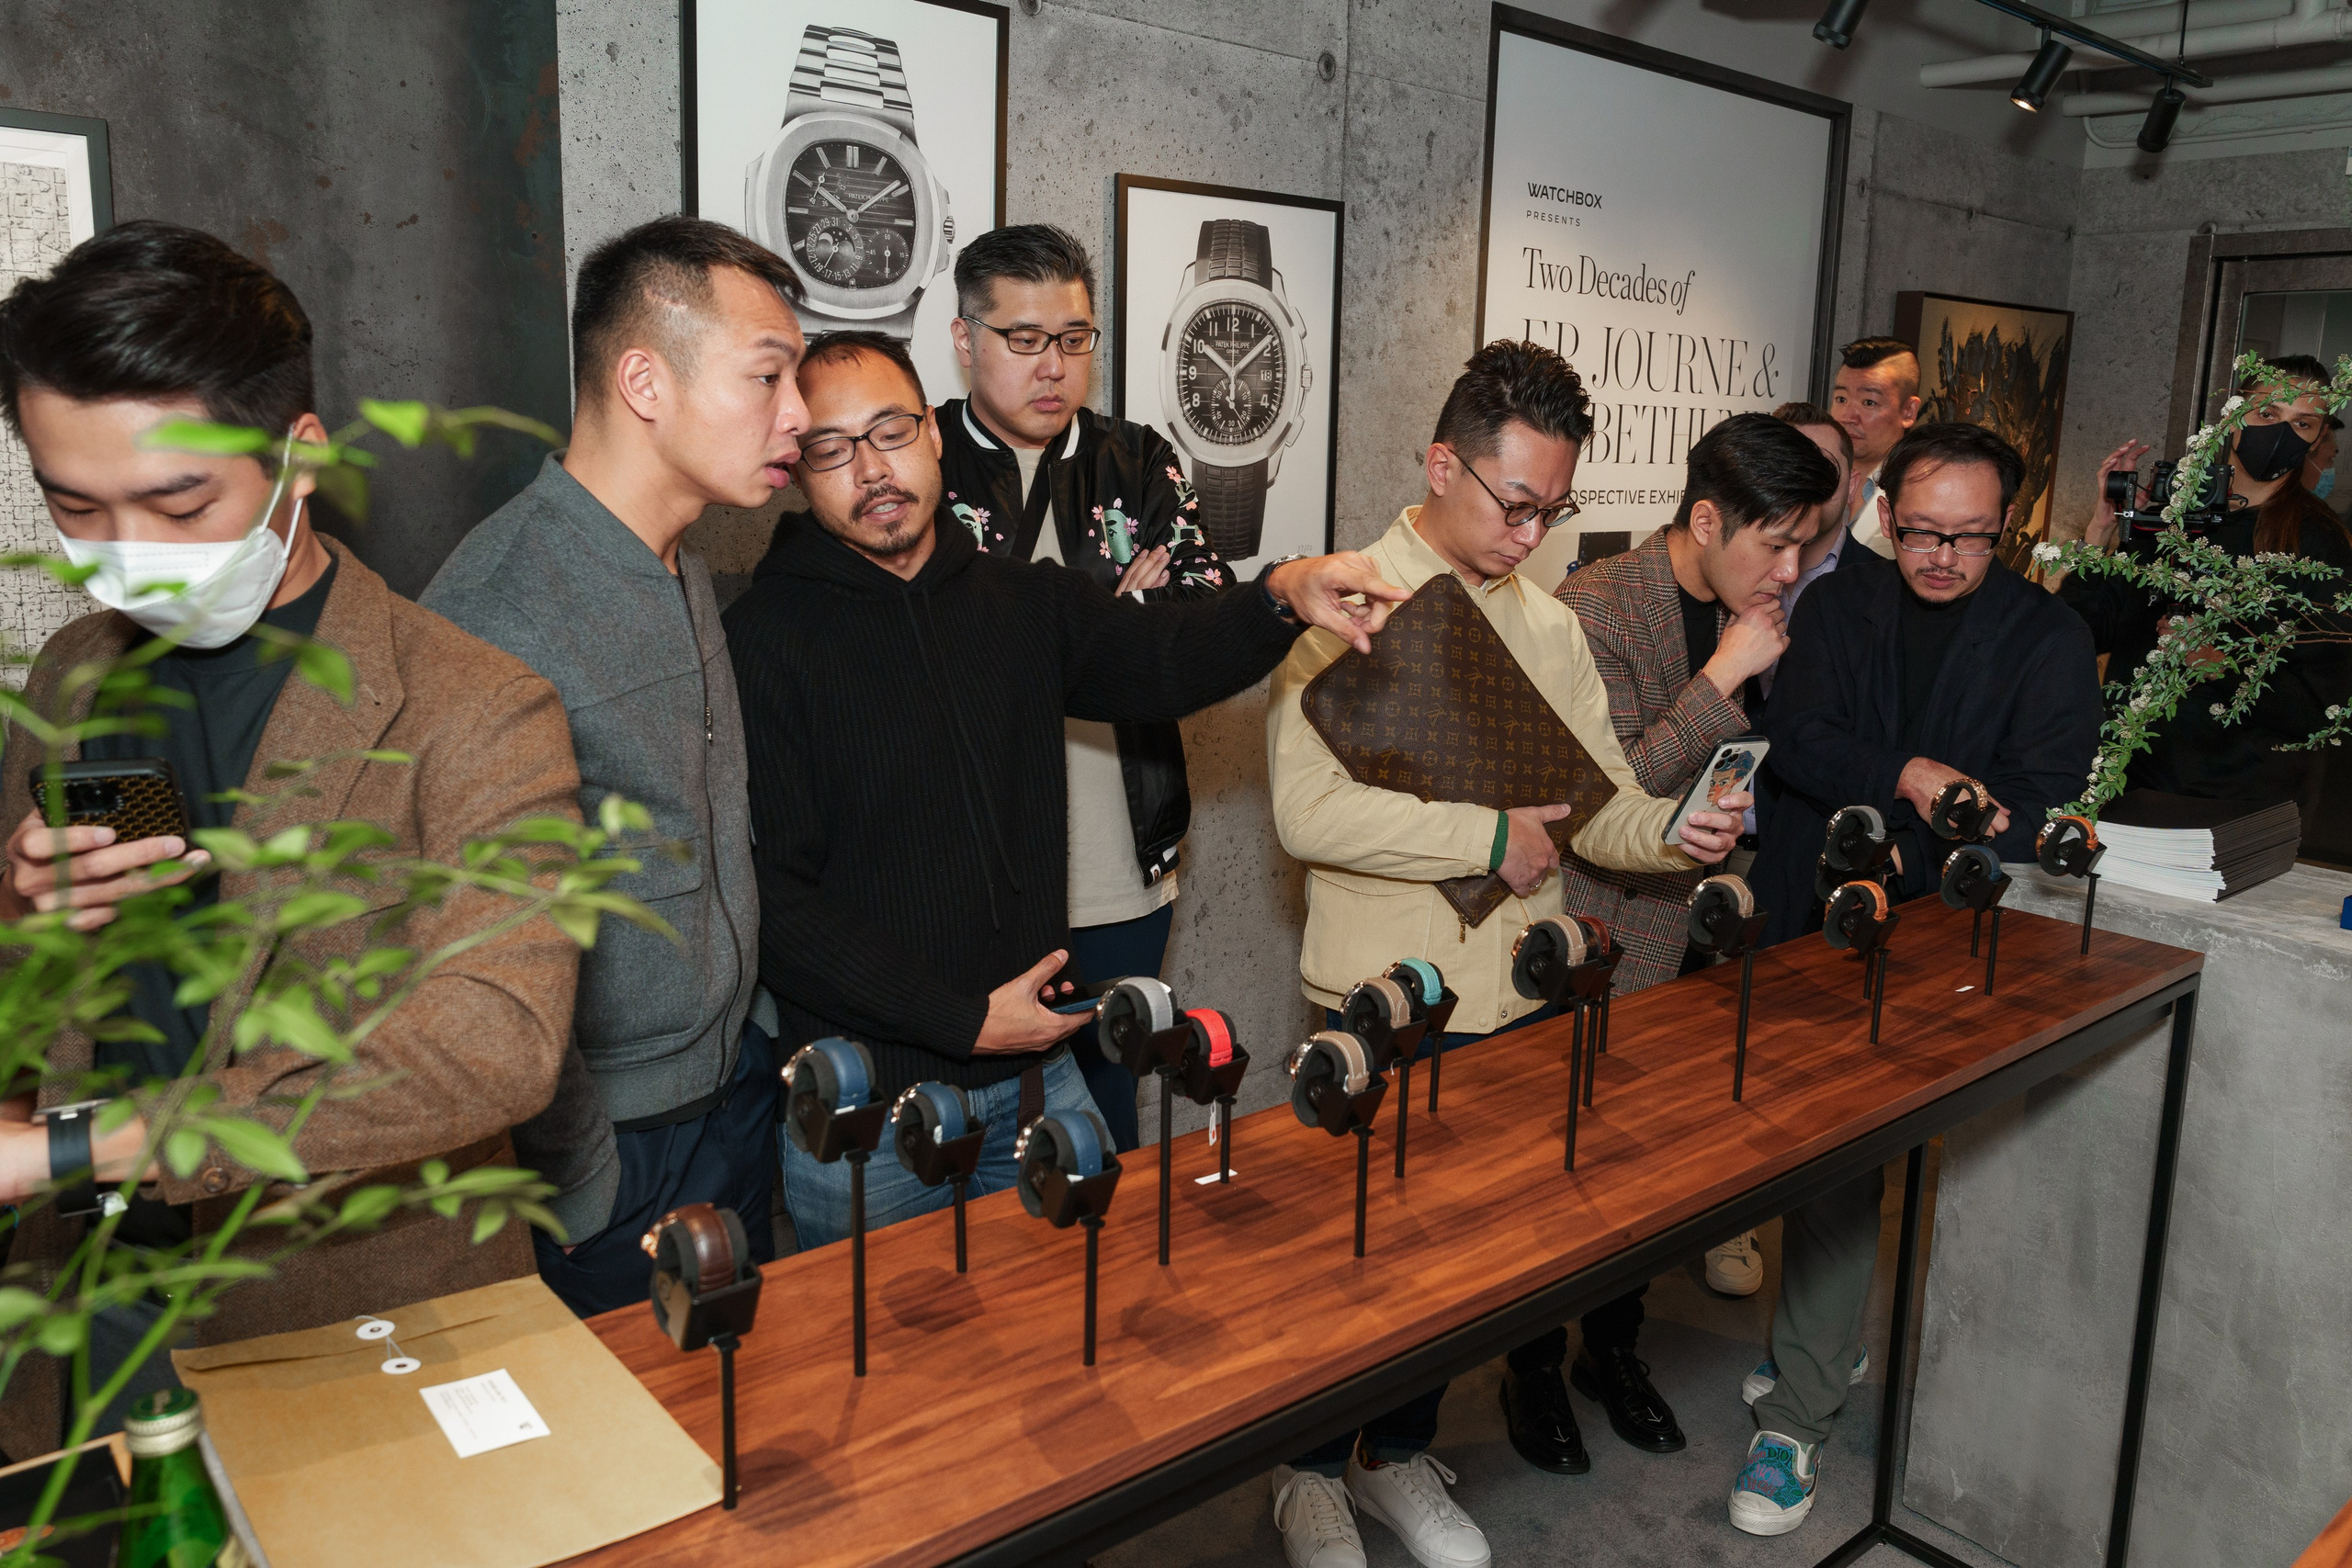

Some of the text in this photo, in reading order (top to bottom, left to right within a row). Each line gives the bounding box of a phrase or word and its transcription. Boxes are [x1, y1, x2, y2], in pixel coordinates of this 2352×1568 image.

[1527, 182, 1602, 209] WATCHBOX
[1526, 210, 1581, 227] PRESENTS
[1522, 247, 1696, 315] Two Decades of
[1227, 317, 1239, 332] 12
[1193, 339, 1205, 355] 10
[1591, 326, 1748, 398] JOURNE
[1753, 343, 1779, 399] &
[1188, 366, 1197, 380] 9
[1192, 392, 1269, 409] 8 4
[1568, 490, 1645, 505] OSPECTIVE
